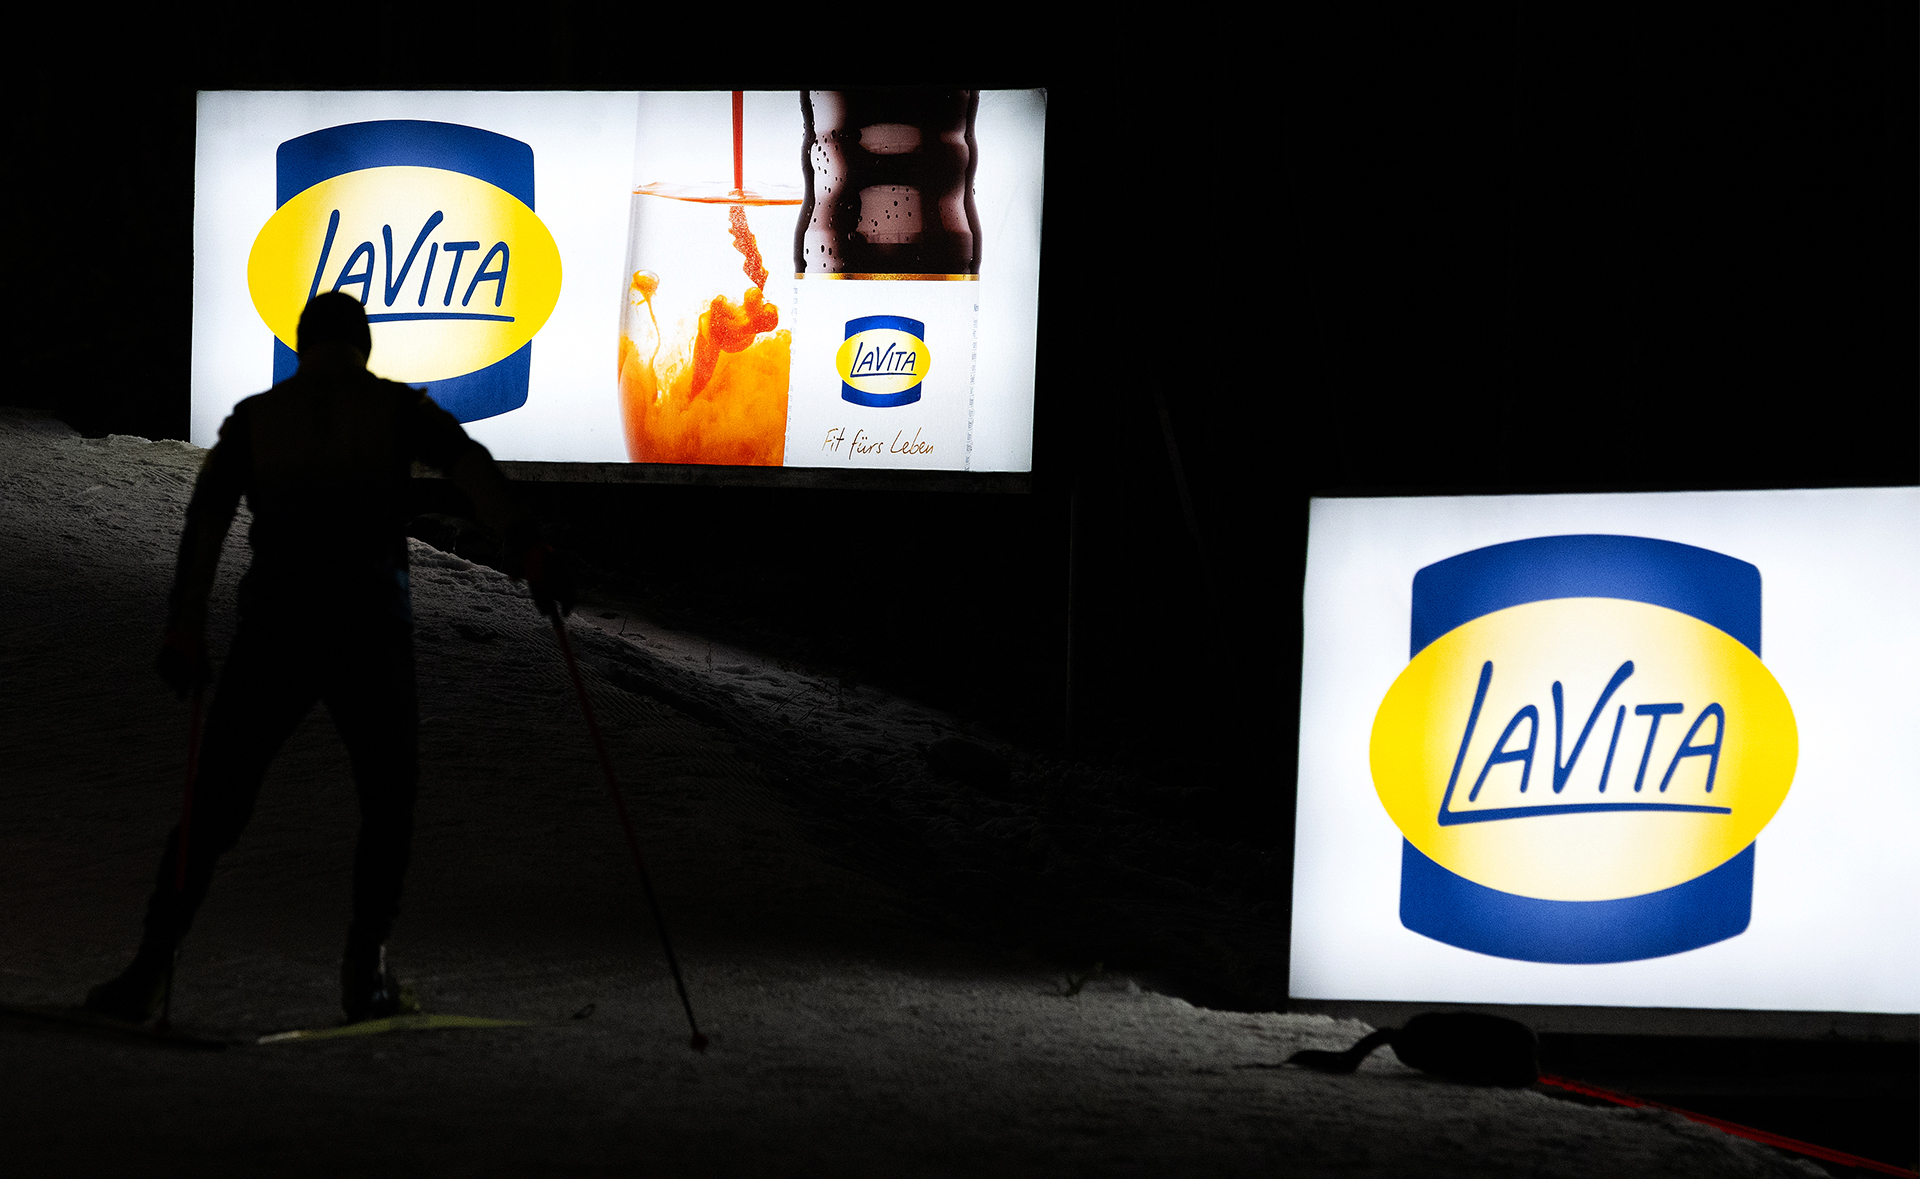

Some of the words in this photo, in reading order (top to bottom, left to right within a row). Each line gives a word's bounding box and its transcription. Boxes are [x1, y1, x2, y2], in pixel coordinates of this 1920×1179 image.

[821, 427, 845, 452] Fit
[849, 429, 883, 460] fürs
[890, 427, 934, 455] Leben
